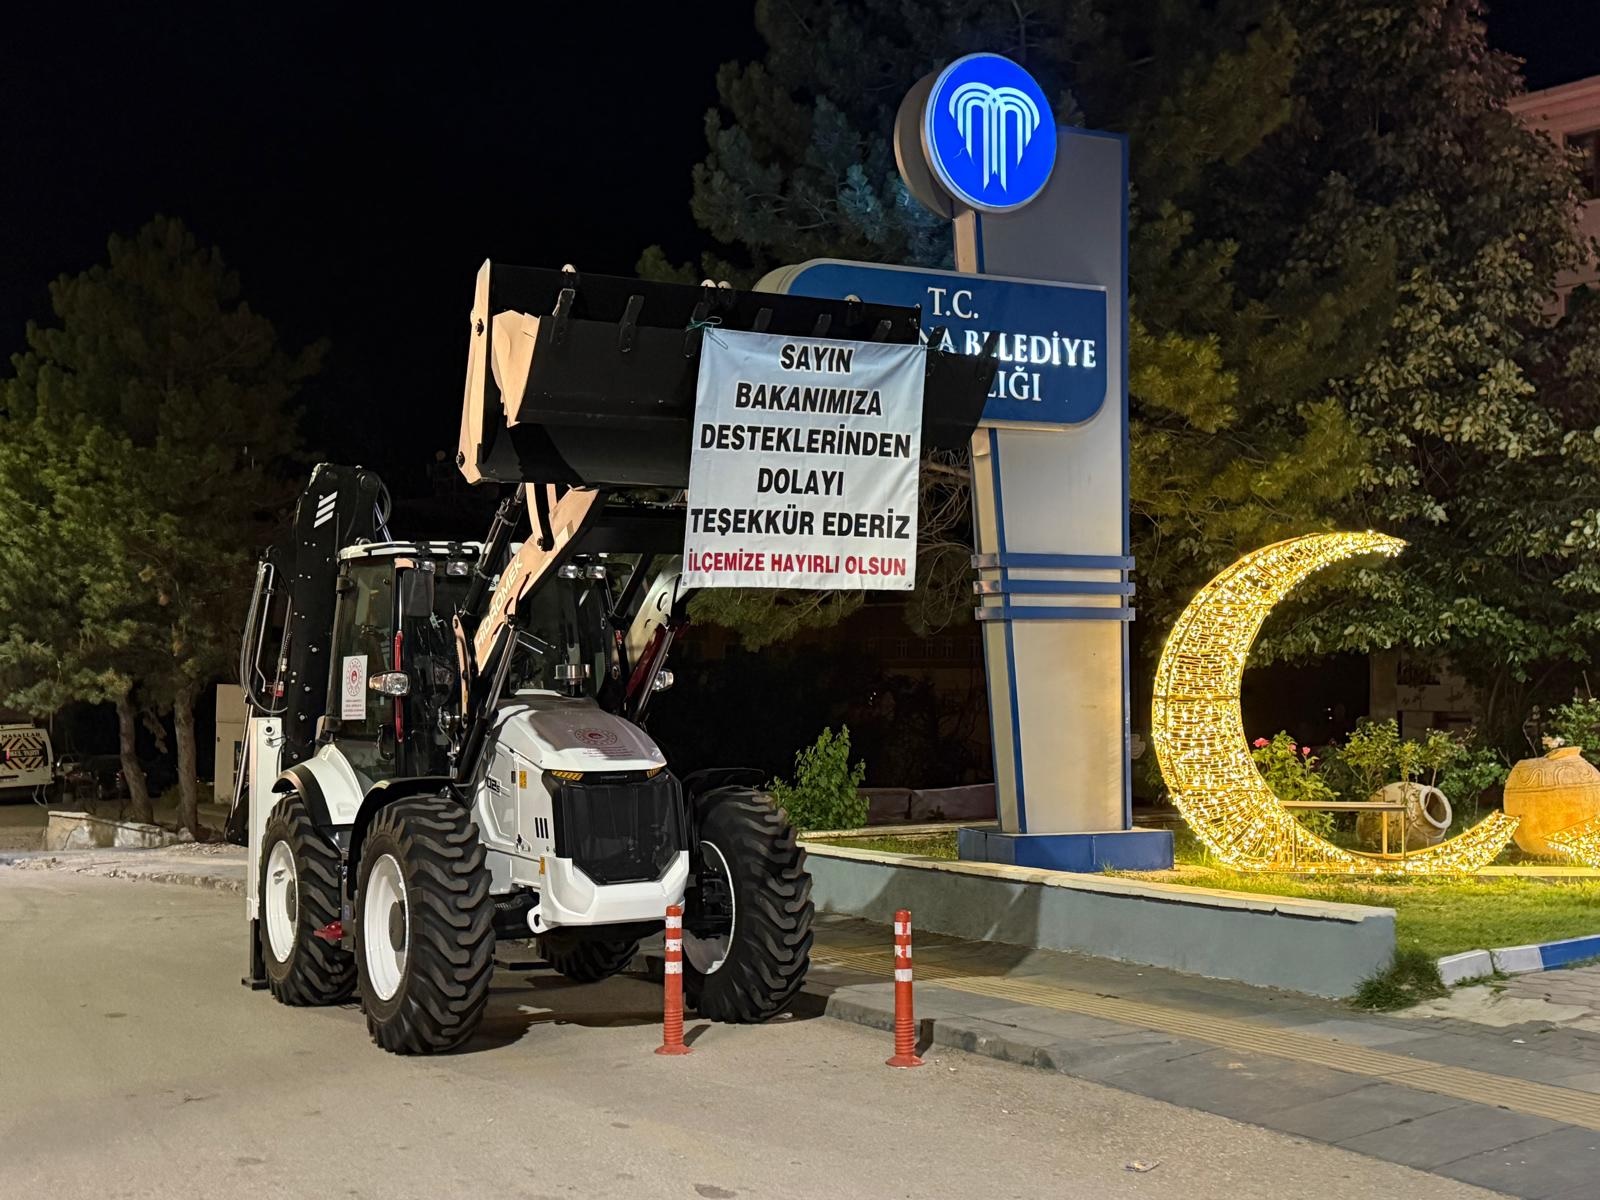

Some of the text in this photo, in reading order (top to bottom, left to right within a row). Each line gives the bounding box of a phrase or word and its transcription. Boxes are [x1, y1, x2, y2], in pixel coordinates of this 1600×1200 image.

[927, 286, 979, 319] T.C.
[780, 344, 853, 373] SAYIN
[735, 382, 882, 416] BAKANIMIZA
[700, 423, 911, 458] DESTEKLERİNDEN
[757, 467, 844, 496] DOLAYI
[690, 504, 910, 539] TEŞEKKÜR EDERİZ
[688, 548, 906, 576] İLÇEMİZE HAYIRLI OLSUN
